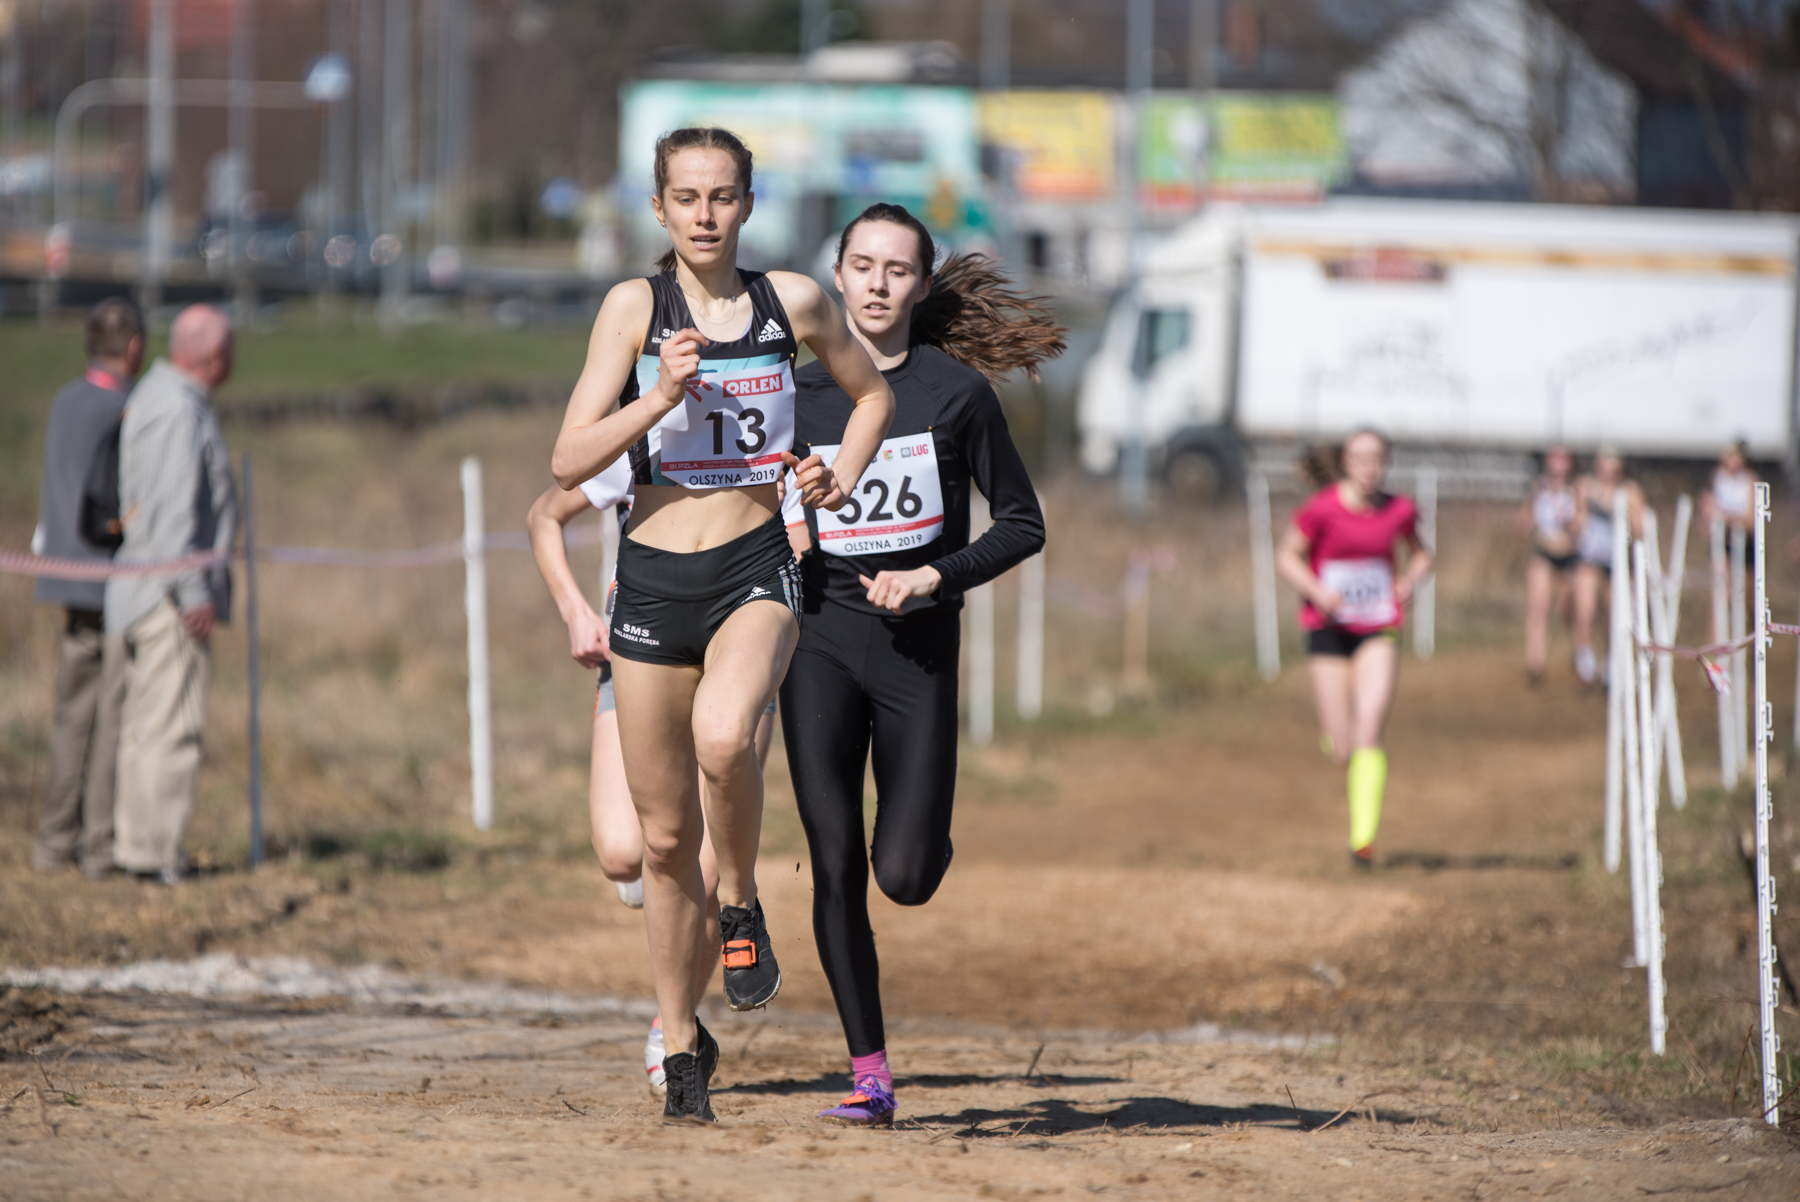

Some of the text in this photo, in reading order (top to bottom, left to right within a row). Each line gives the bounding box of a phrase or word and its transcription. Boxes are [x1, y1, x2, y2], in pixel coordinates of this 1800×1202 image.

[758, 331, 786, 342] adidas
[725, 376, 781, 395] ORLEN
[704, 407, 767, 455] 13
[911, 443, 929, 456] LUG
[688, 469, 775, 486] OLSZYNA 2019
[844, 534, 923, 553] OLSZYNA 2019
[622, 623, 650, 637] SMS
